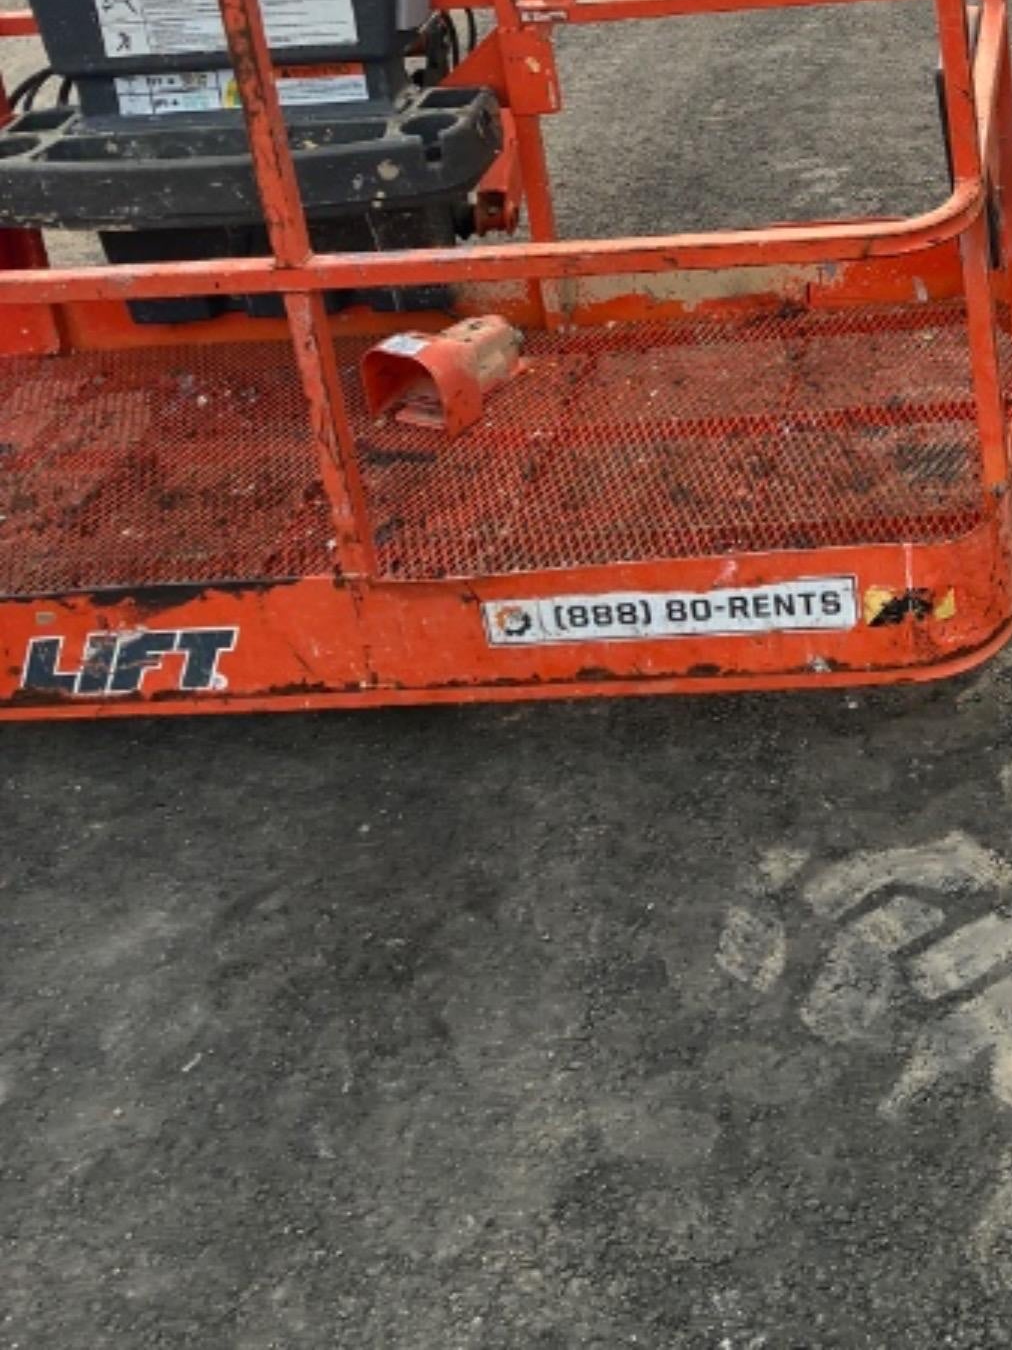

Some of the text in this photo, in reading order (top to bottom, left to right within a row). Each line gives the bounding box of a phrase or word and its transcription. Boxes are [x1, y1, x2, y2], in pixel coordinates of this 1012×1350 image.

[553, 590, 842, 632] (888) 80-RENTS
[20, 626, 239, 695] LIFT
